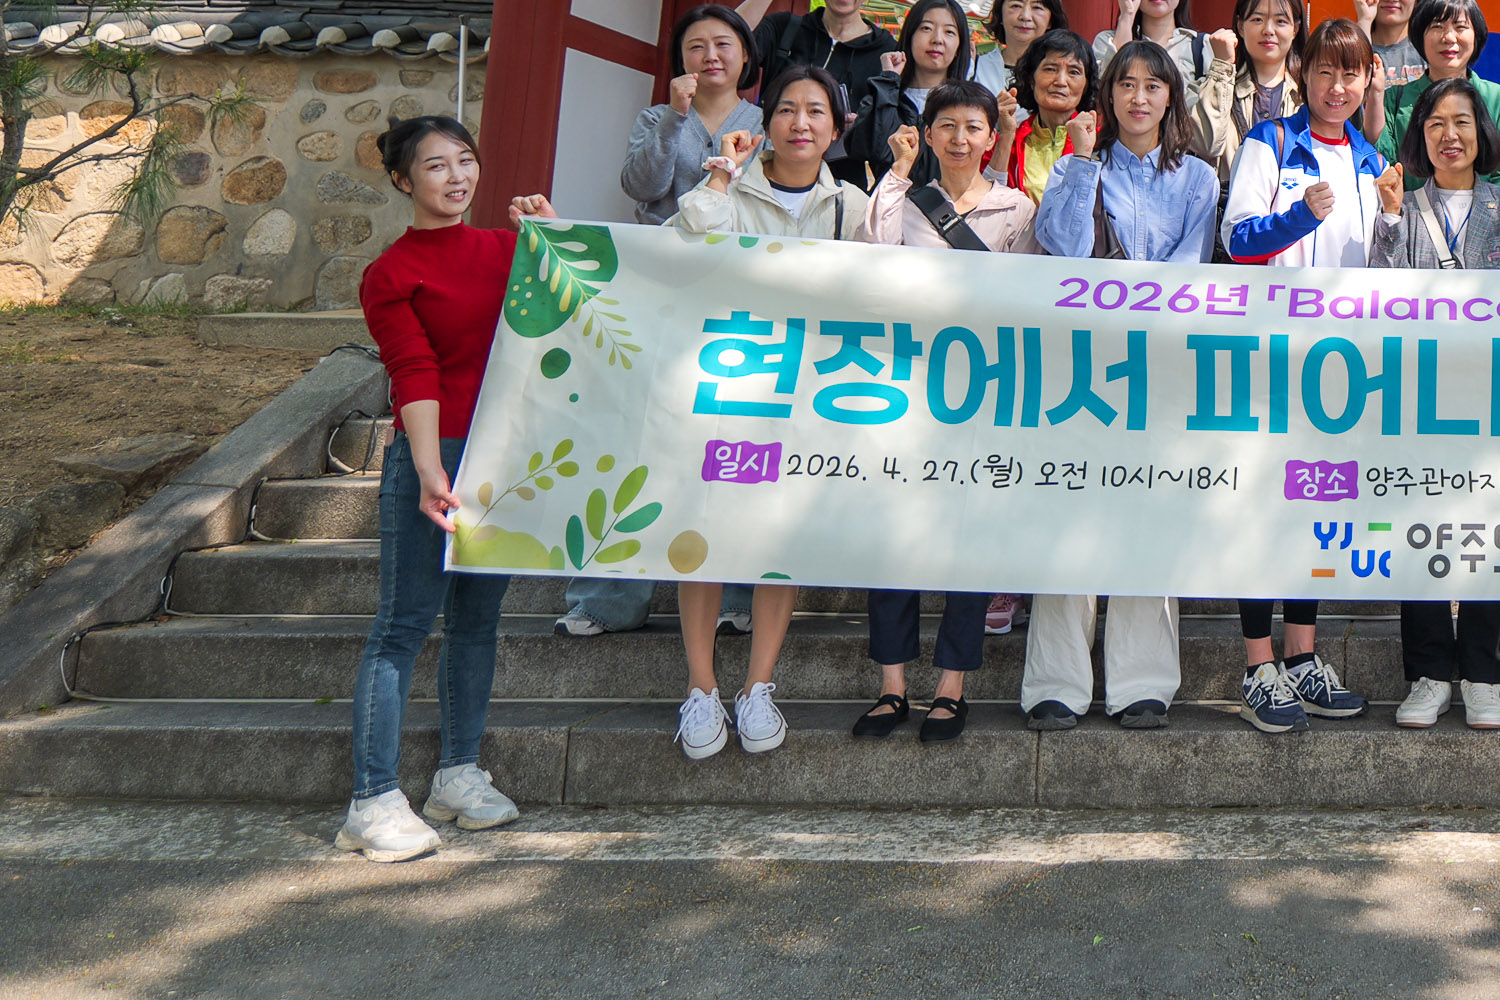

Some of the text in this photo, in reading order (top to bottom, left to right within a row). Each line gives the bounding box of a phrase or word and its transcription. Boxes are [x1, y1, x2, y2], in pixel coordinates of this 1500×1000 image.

[1055, 277, 1248, 316] 2026년
[692, 310, 1148, 431] 현장에서
[715, 444, 770, 479] 일시
[786, 454, 867, 481] 2026.
[883, 456, 907, 482] 4.
[1034, 460, 1088, 491] 오전
[1101, 464, 1239, 491] 10시~18시
[1295, 466, 1349, 498] 장소
